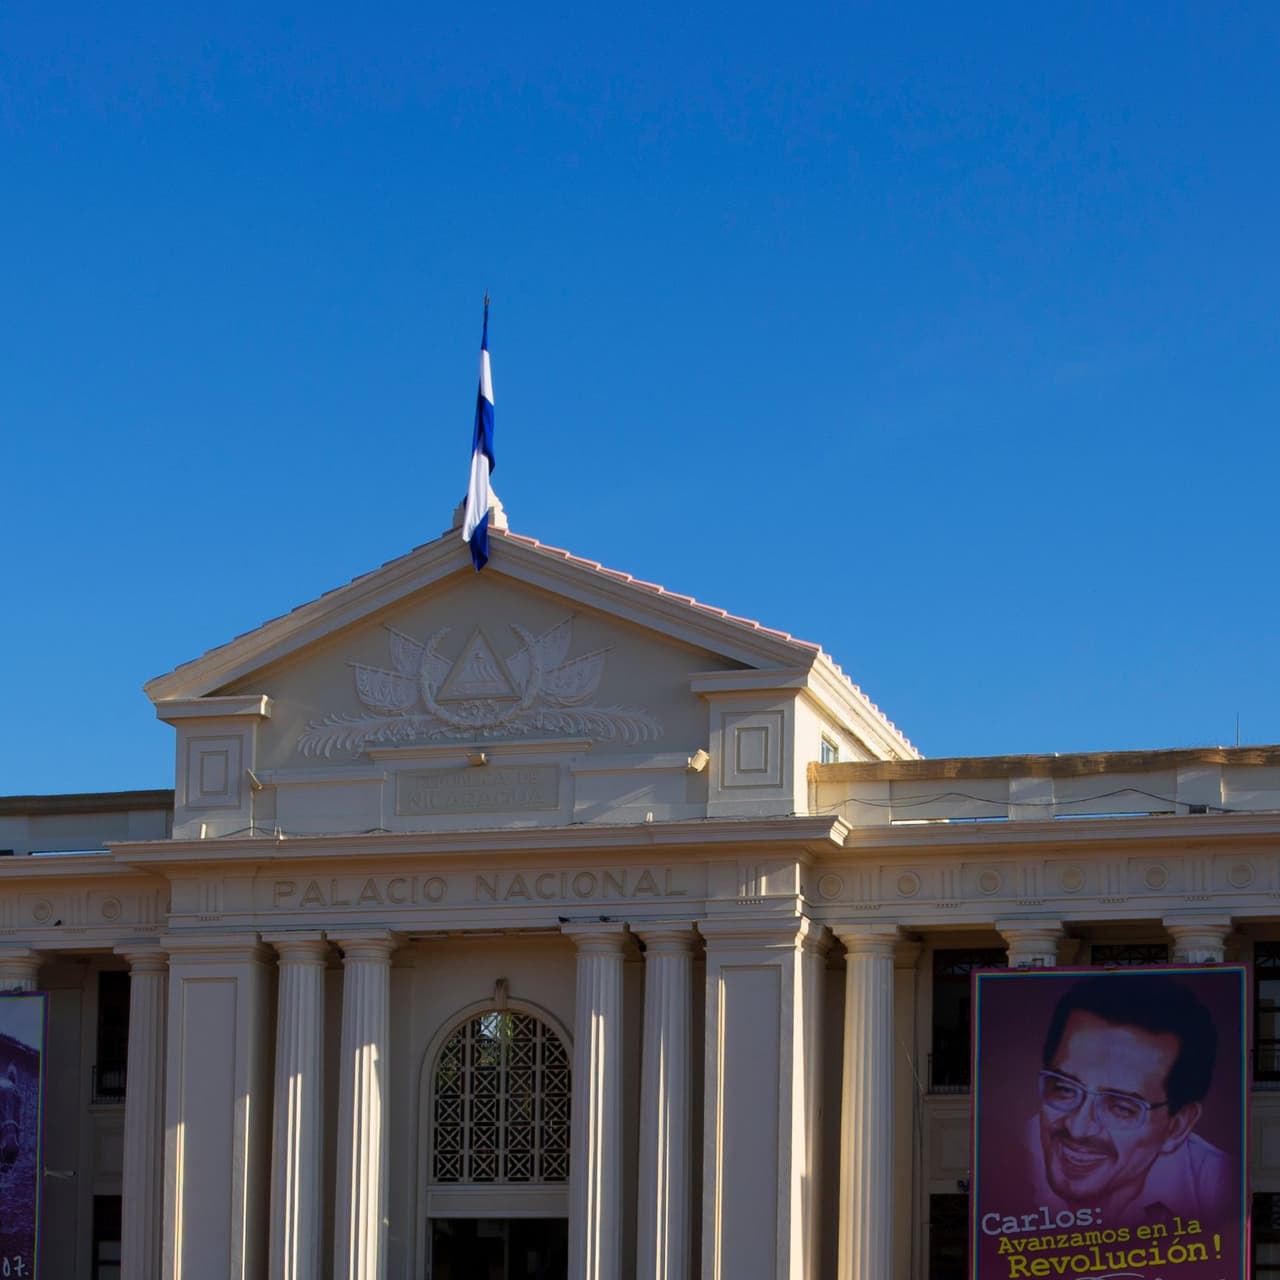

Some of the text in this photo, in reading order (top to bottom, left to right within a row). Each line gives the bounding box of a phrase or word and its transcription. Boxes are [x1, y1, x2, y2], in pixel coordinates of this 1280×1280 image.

[272, 868, 689, 907] PALACIO NACIONAL
[981, 1206, 1104, 1236] Carlos:
[998, 1216, 1203, 1255] Avanzamos en la
[1008, 1233, 1222, 1280] Revolución!
